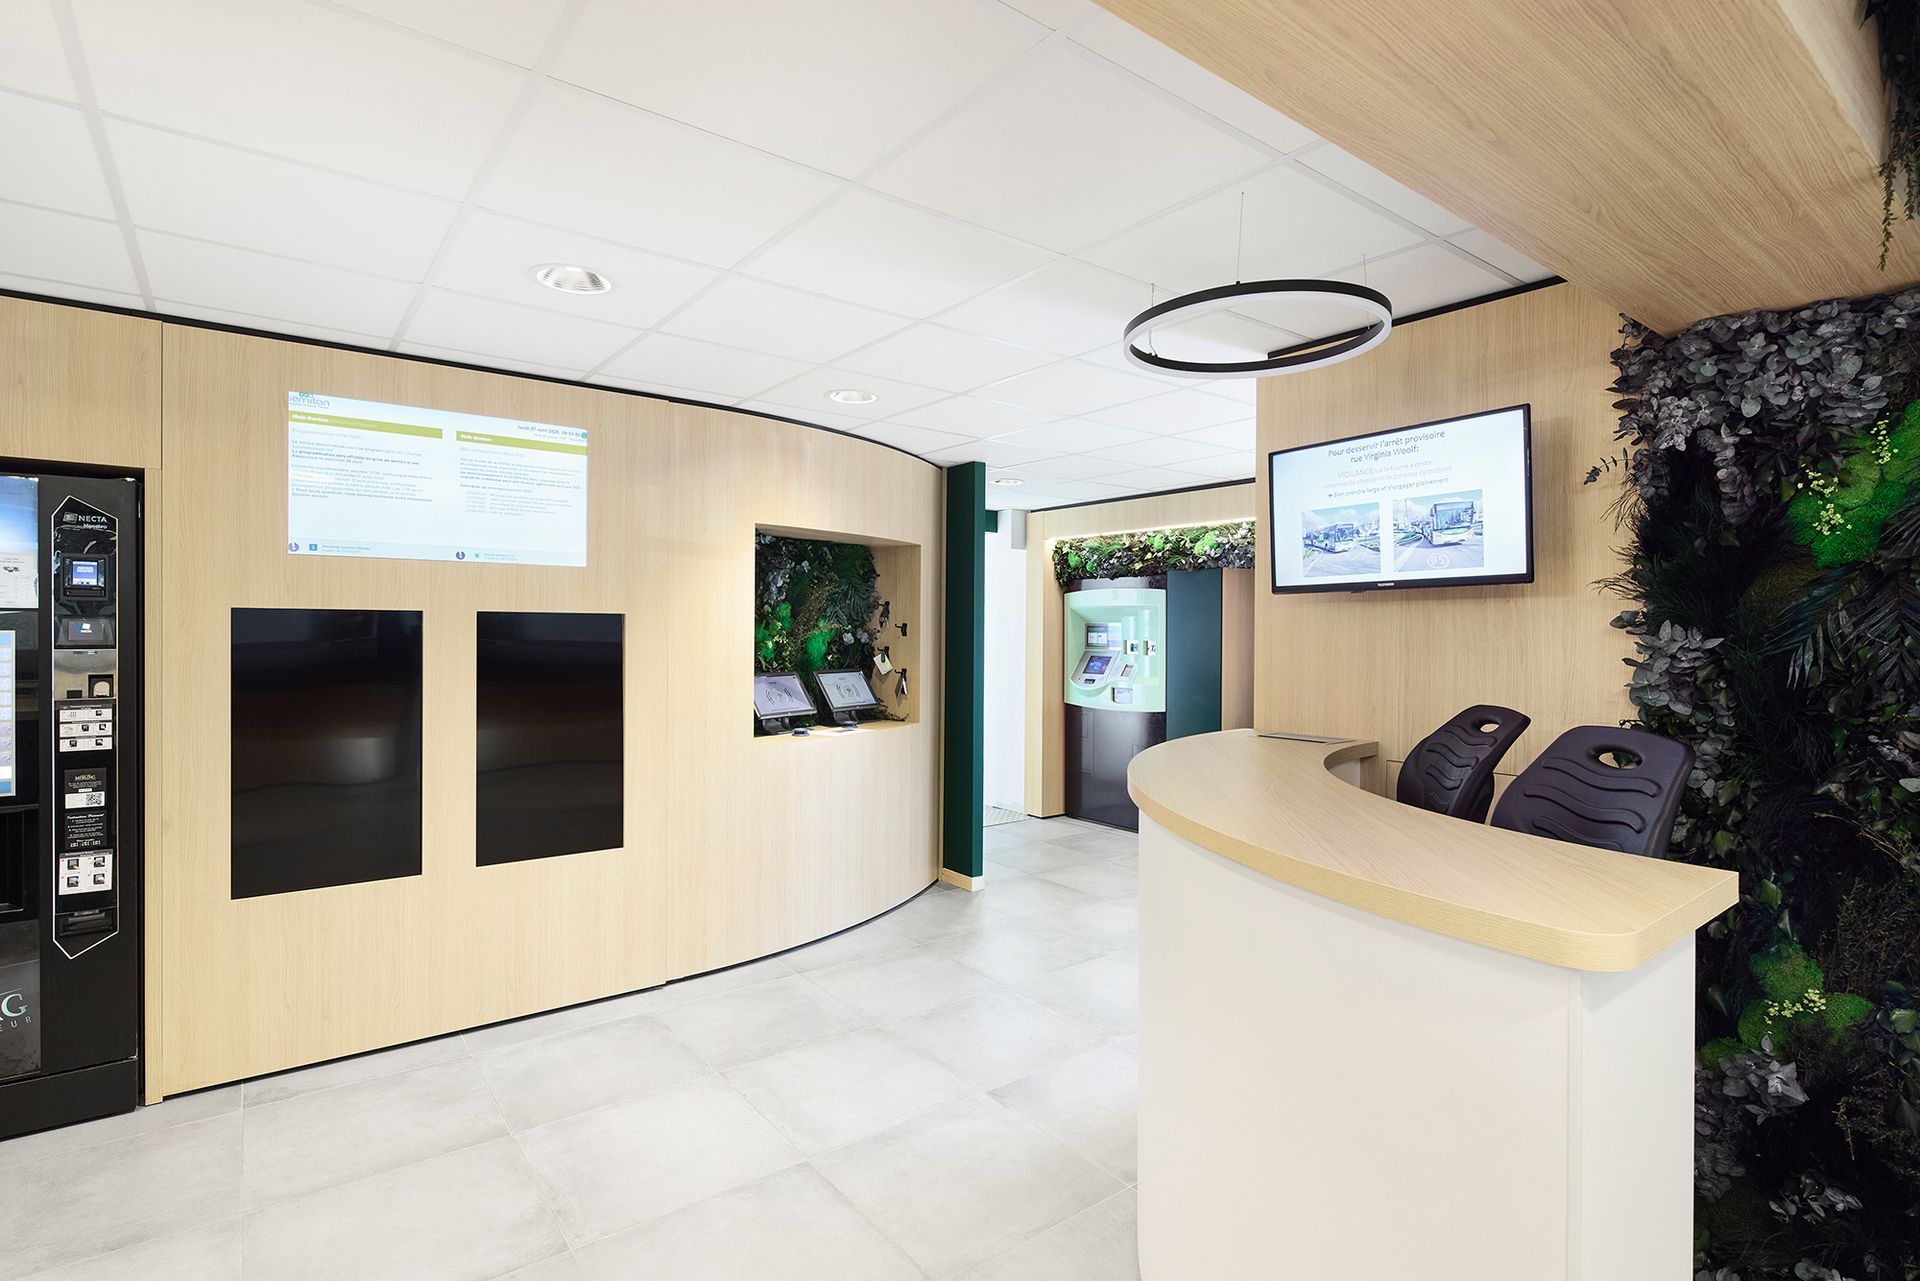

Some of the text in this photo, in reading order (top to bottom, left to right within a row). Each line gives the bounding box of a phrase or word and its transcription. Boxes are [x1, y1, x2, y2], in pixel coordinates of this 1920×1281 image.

[1328, 449, 1345, 457] Pour
[1346, 442, 1379, 453] desservir
[1405, 431, 1445, 445] provisoire
[1365, 449, 1391, 461] Virginia
[1337, 466, 1373, 479] VIGILANCE
[1416, 478, 1449, 488] pleinement
[79, 515, 108, 523] NECTA
